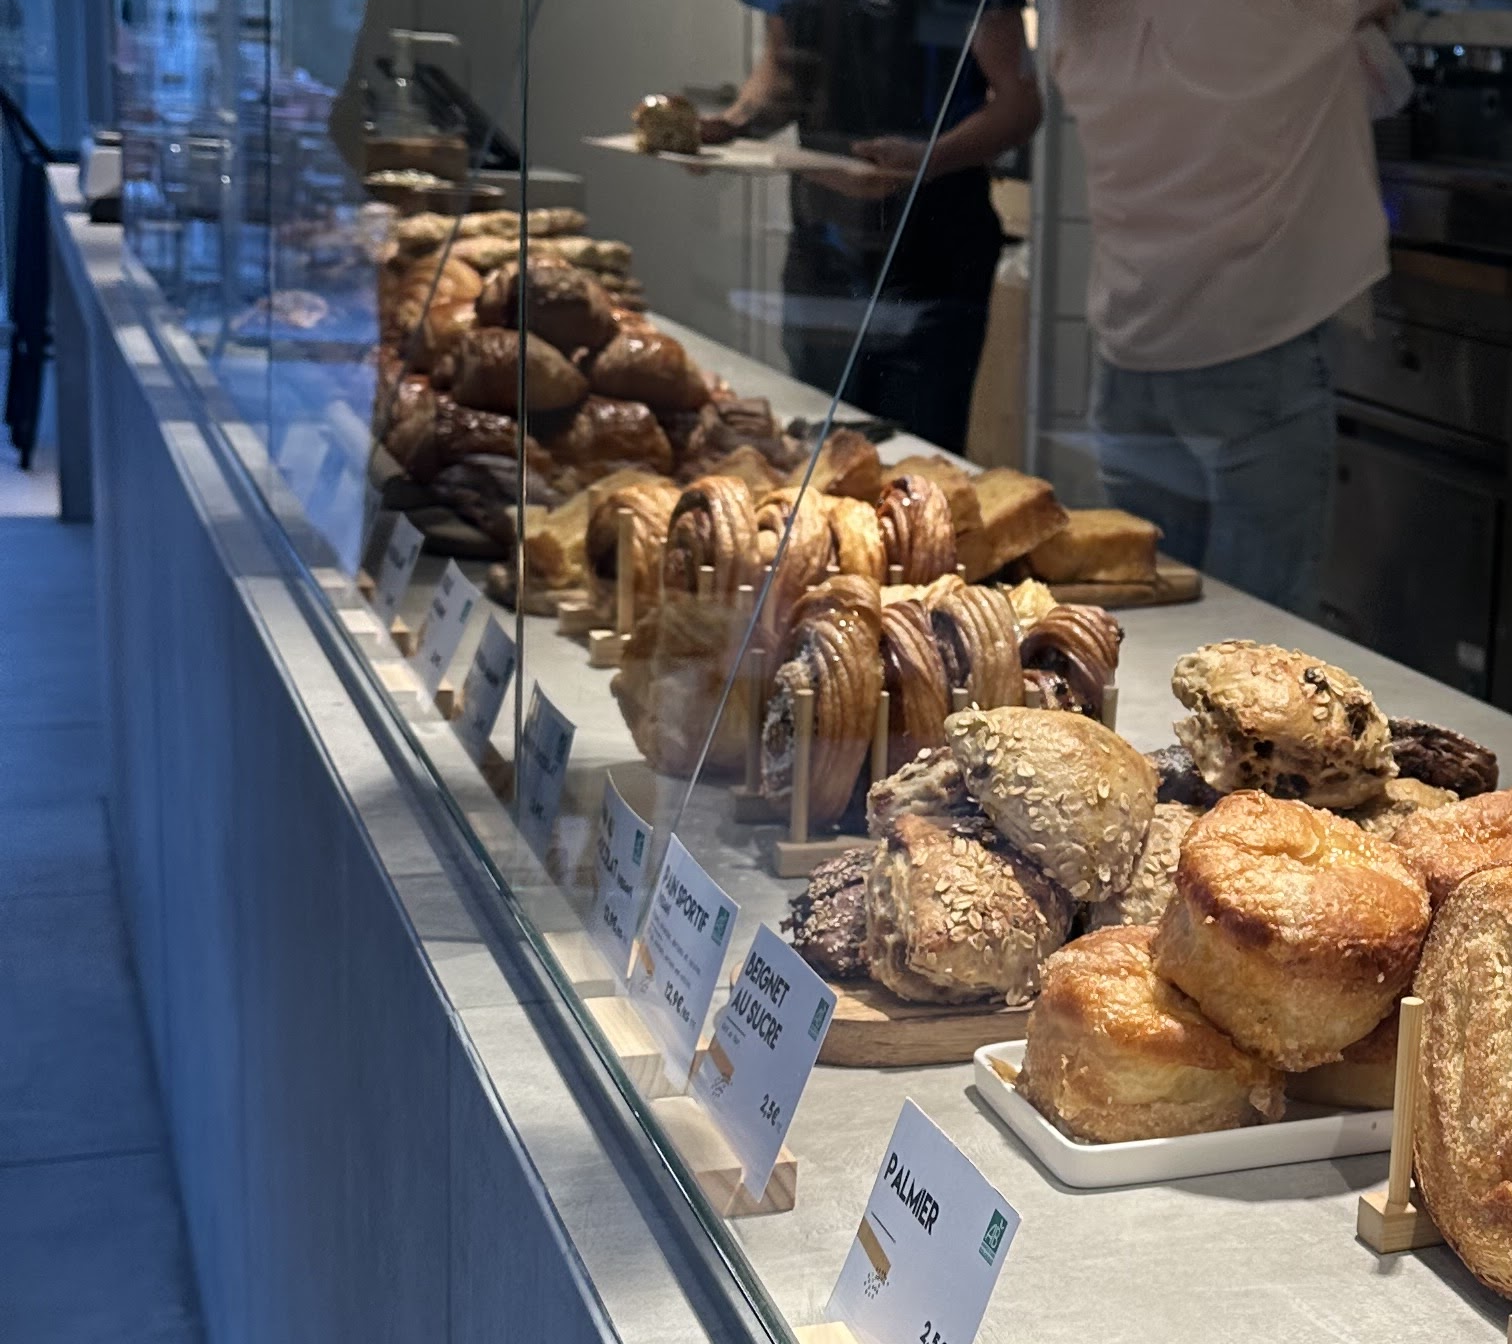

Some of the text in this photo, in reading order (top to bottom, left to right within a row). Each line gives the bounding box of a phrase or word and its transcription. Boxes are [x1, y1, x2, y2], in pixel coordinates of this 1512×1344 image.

[675, 883, 711, 934] SPORTIF
[744, 950, 791, 1009] BEIGNET
[730, 987, 749, 1017] AU
[746, 999, 784, 1051] SUCRE
[759, 1092, 781, 1127] 2,5€
[883, 1151, 940, 1236] PALMIER
